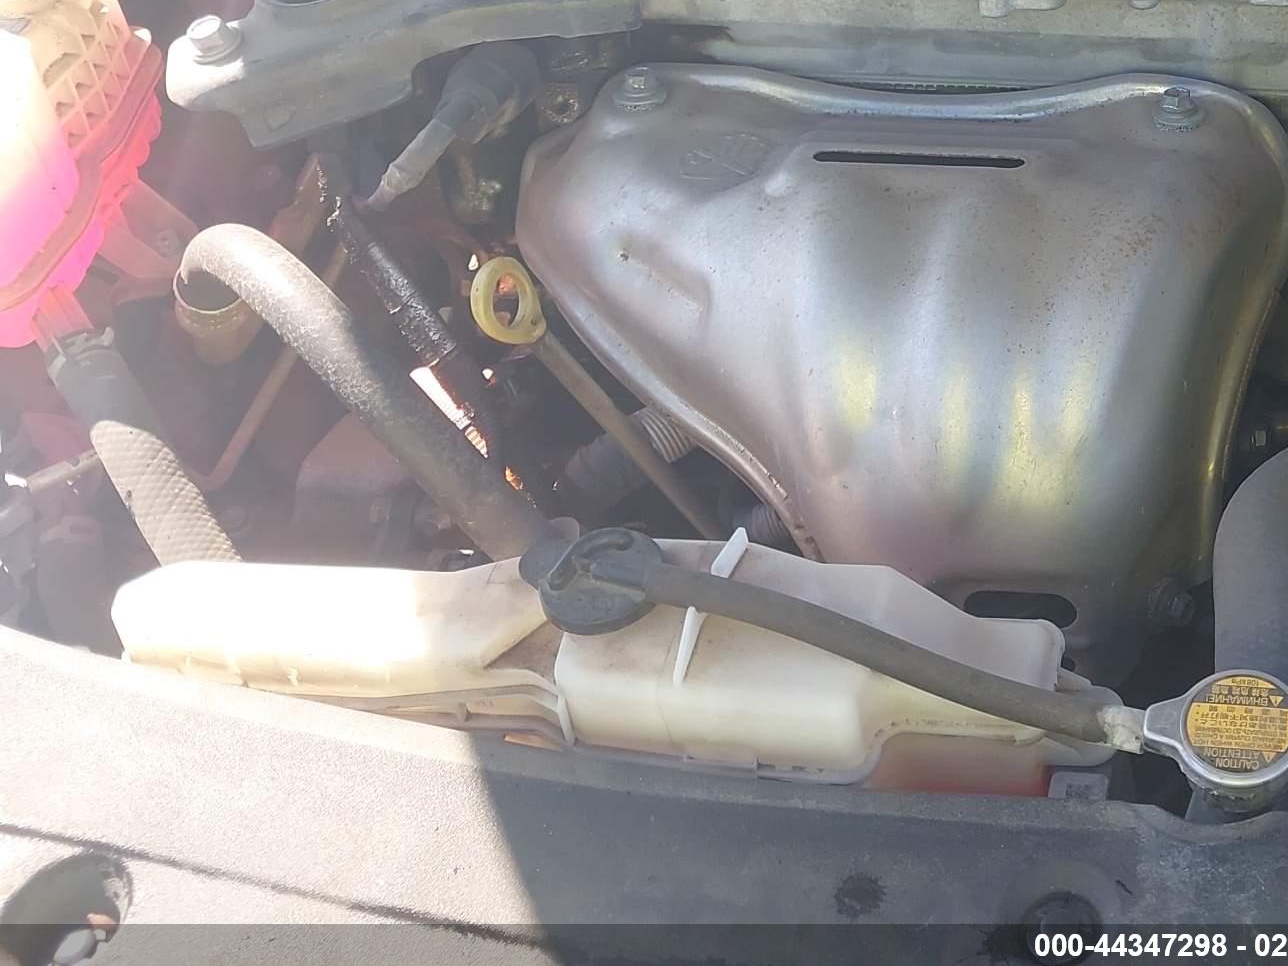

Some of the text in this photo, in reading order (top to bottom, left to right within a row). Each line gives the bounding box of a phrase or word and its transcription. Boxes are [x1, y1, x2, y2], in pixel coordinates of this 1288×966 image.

[1206, 694, 1268, 706] ВНИМАНИЕ!
[1204, 747, 1259, 759] ATTENTION
[1215, 758, 1259, 770] CAUTION
